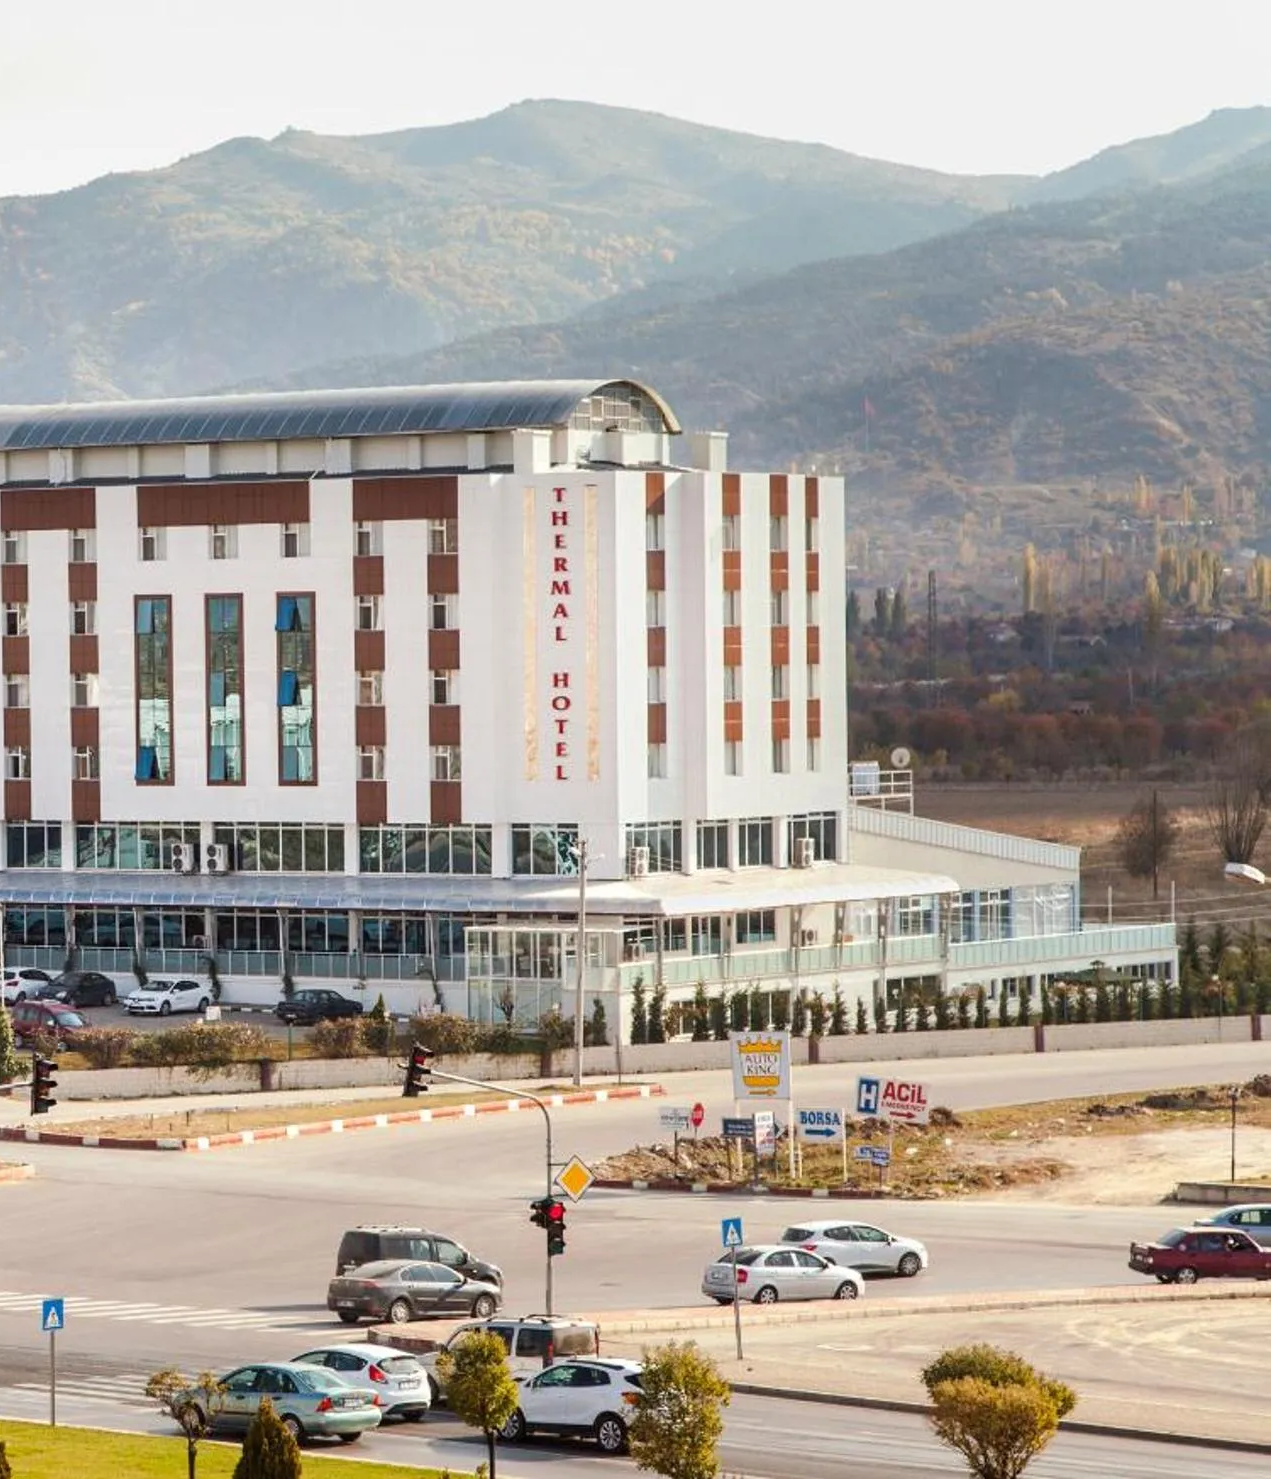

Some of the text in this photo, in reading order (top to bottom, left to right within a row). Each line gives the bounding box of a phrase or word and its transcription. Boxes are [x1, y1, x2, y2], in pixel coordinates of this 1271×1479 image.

[550, 487, 572, 780] THERMAL HOTEL
[745, 1054, 778, 1065] AUTO
[747, 1064, 777, 1075] KING
[859, 1083, 878, 1110] H
[799, 1110, 841, 1126] BORSA
